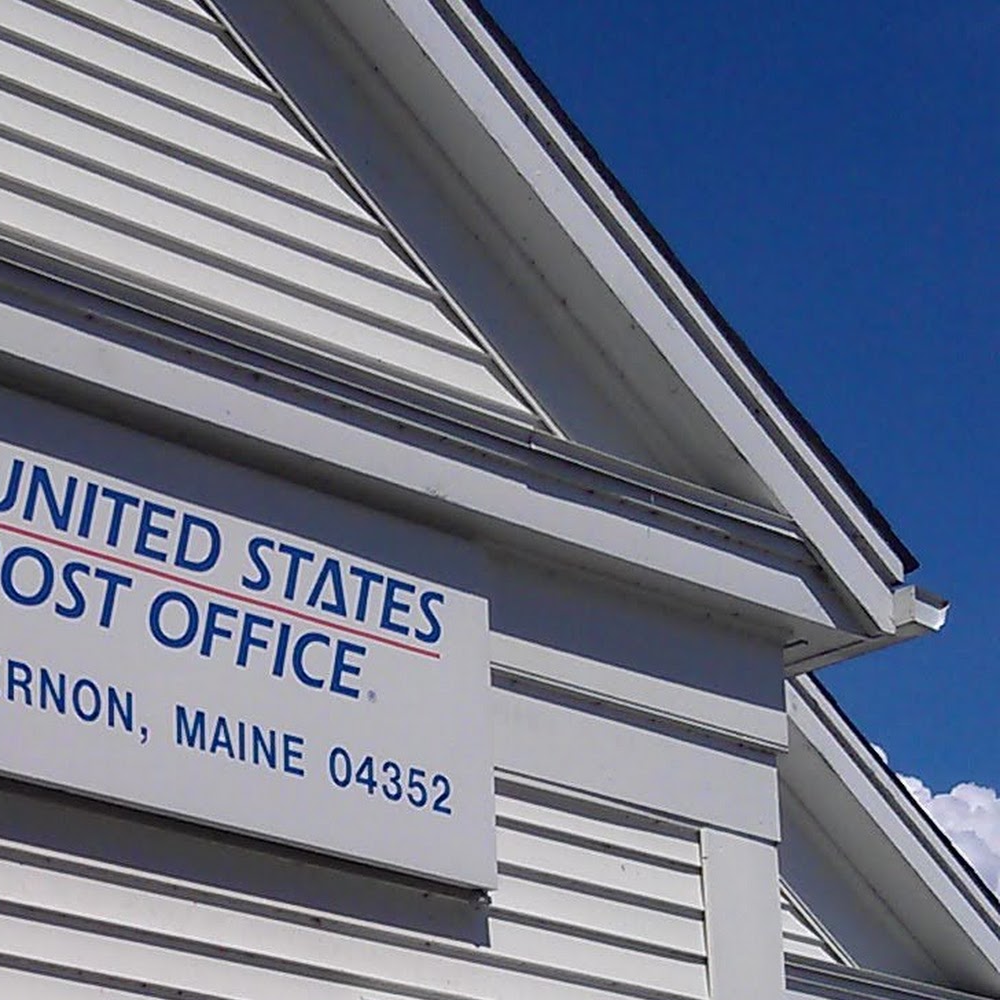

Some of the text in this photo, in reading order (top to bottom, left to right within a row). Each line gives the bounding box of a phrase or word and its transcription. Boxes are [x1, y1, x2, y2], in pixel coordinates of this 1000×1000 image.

[149, 591, 367, 699] OFFICE
[241, 537, 444, 645] STATES
[176, 705, 305, 777] MAINE
[329, 746, 453, 815] 04352
